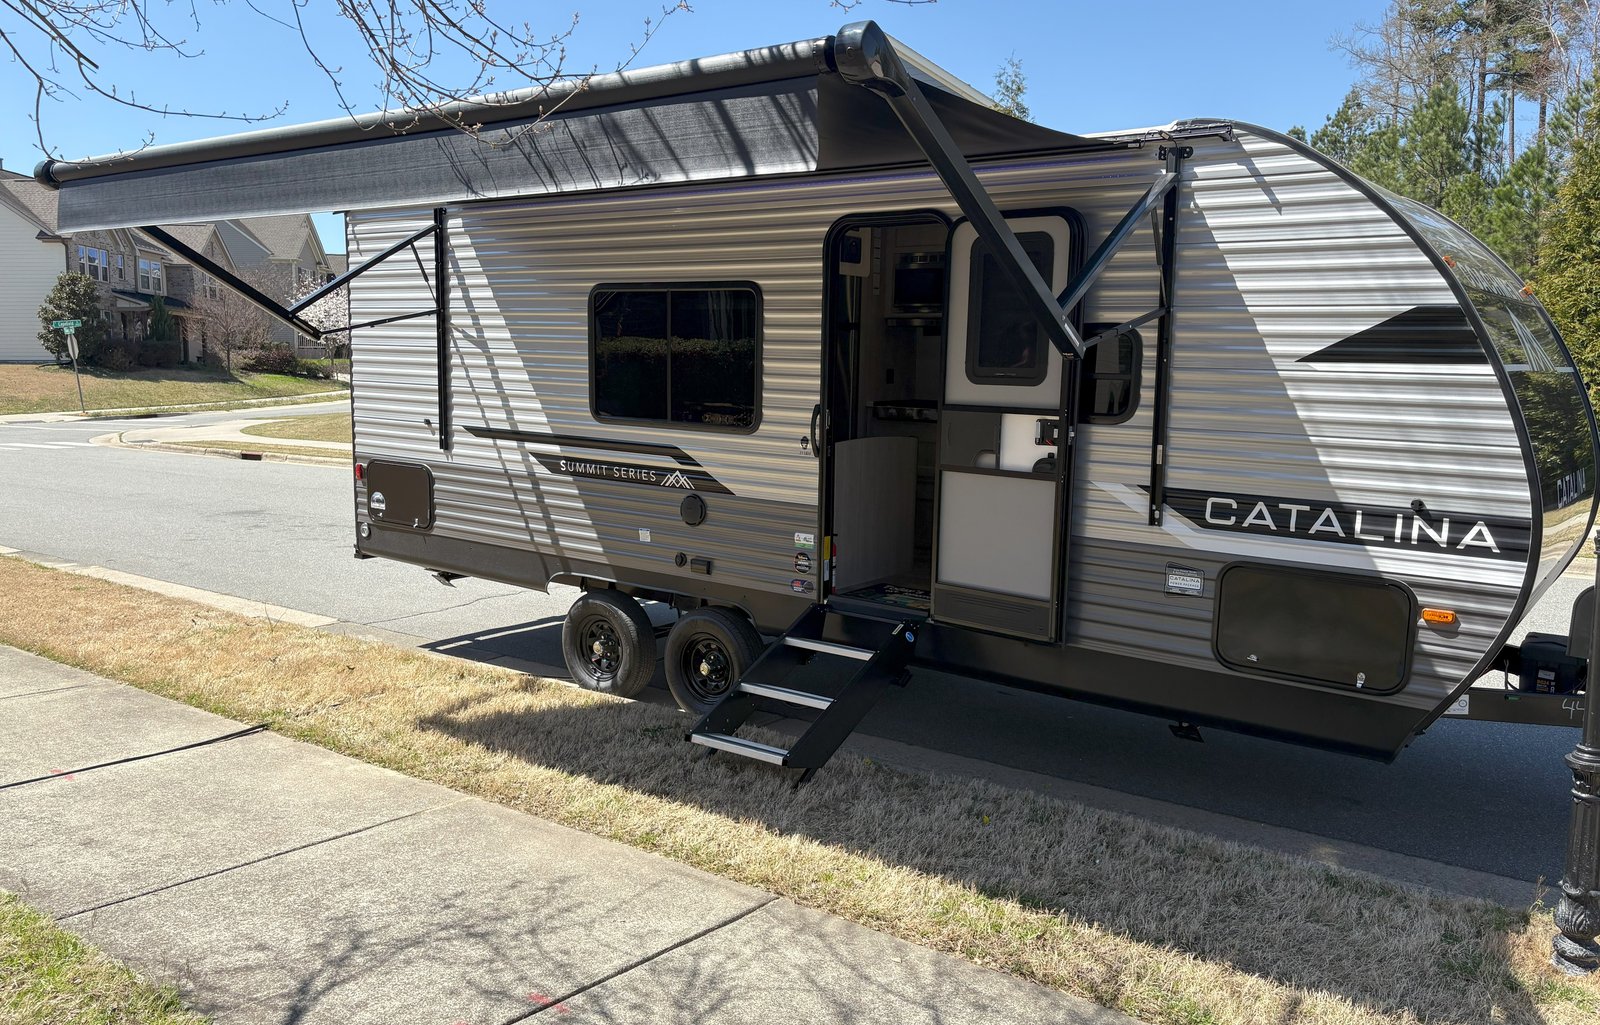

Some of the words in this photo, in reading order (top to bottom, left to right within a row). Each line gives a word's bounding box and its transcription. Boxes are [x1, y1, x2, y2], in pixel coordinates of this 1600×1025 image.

[560, 460, 607, 476] SUMMIT
[613, 466, 656, 481] SERIES
[1205, 497, 1500, 553] CATALINA
[1169, 575, 1200, 583] CATALINA
